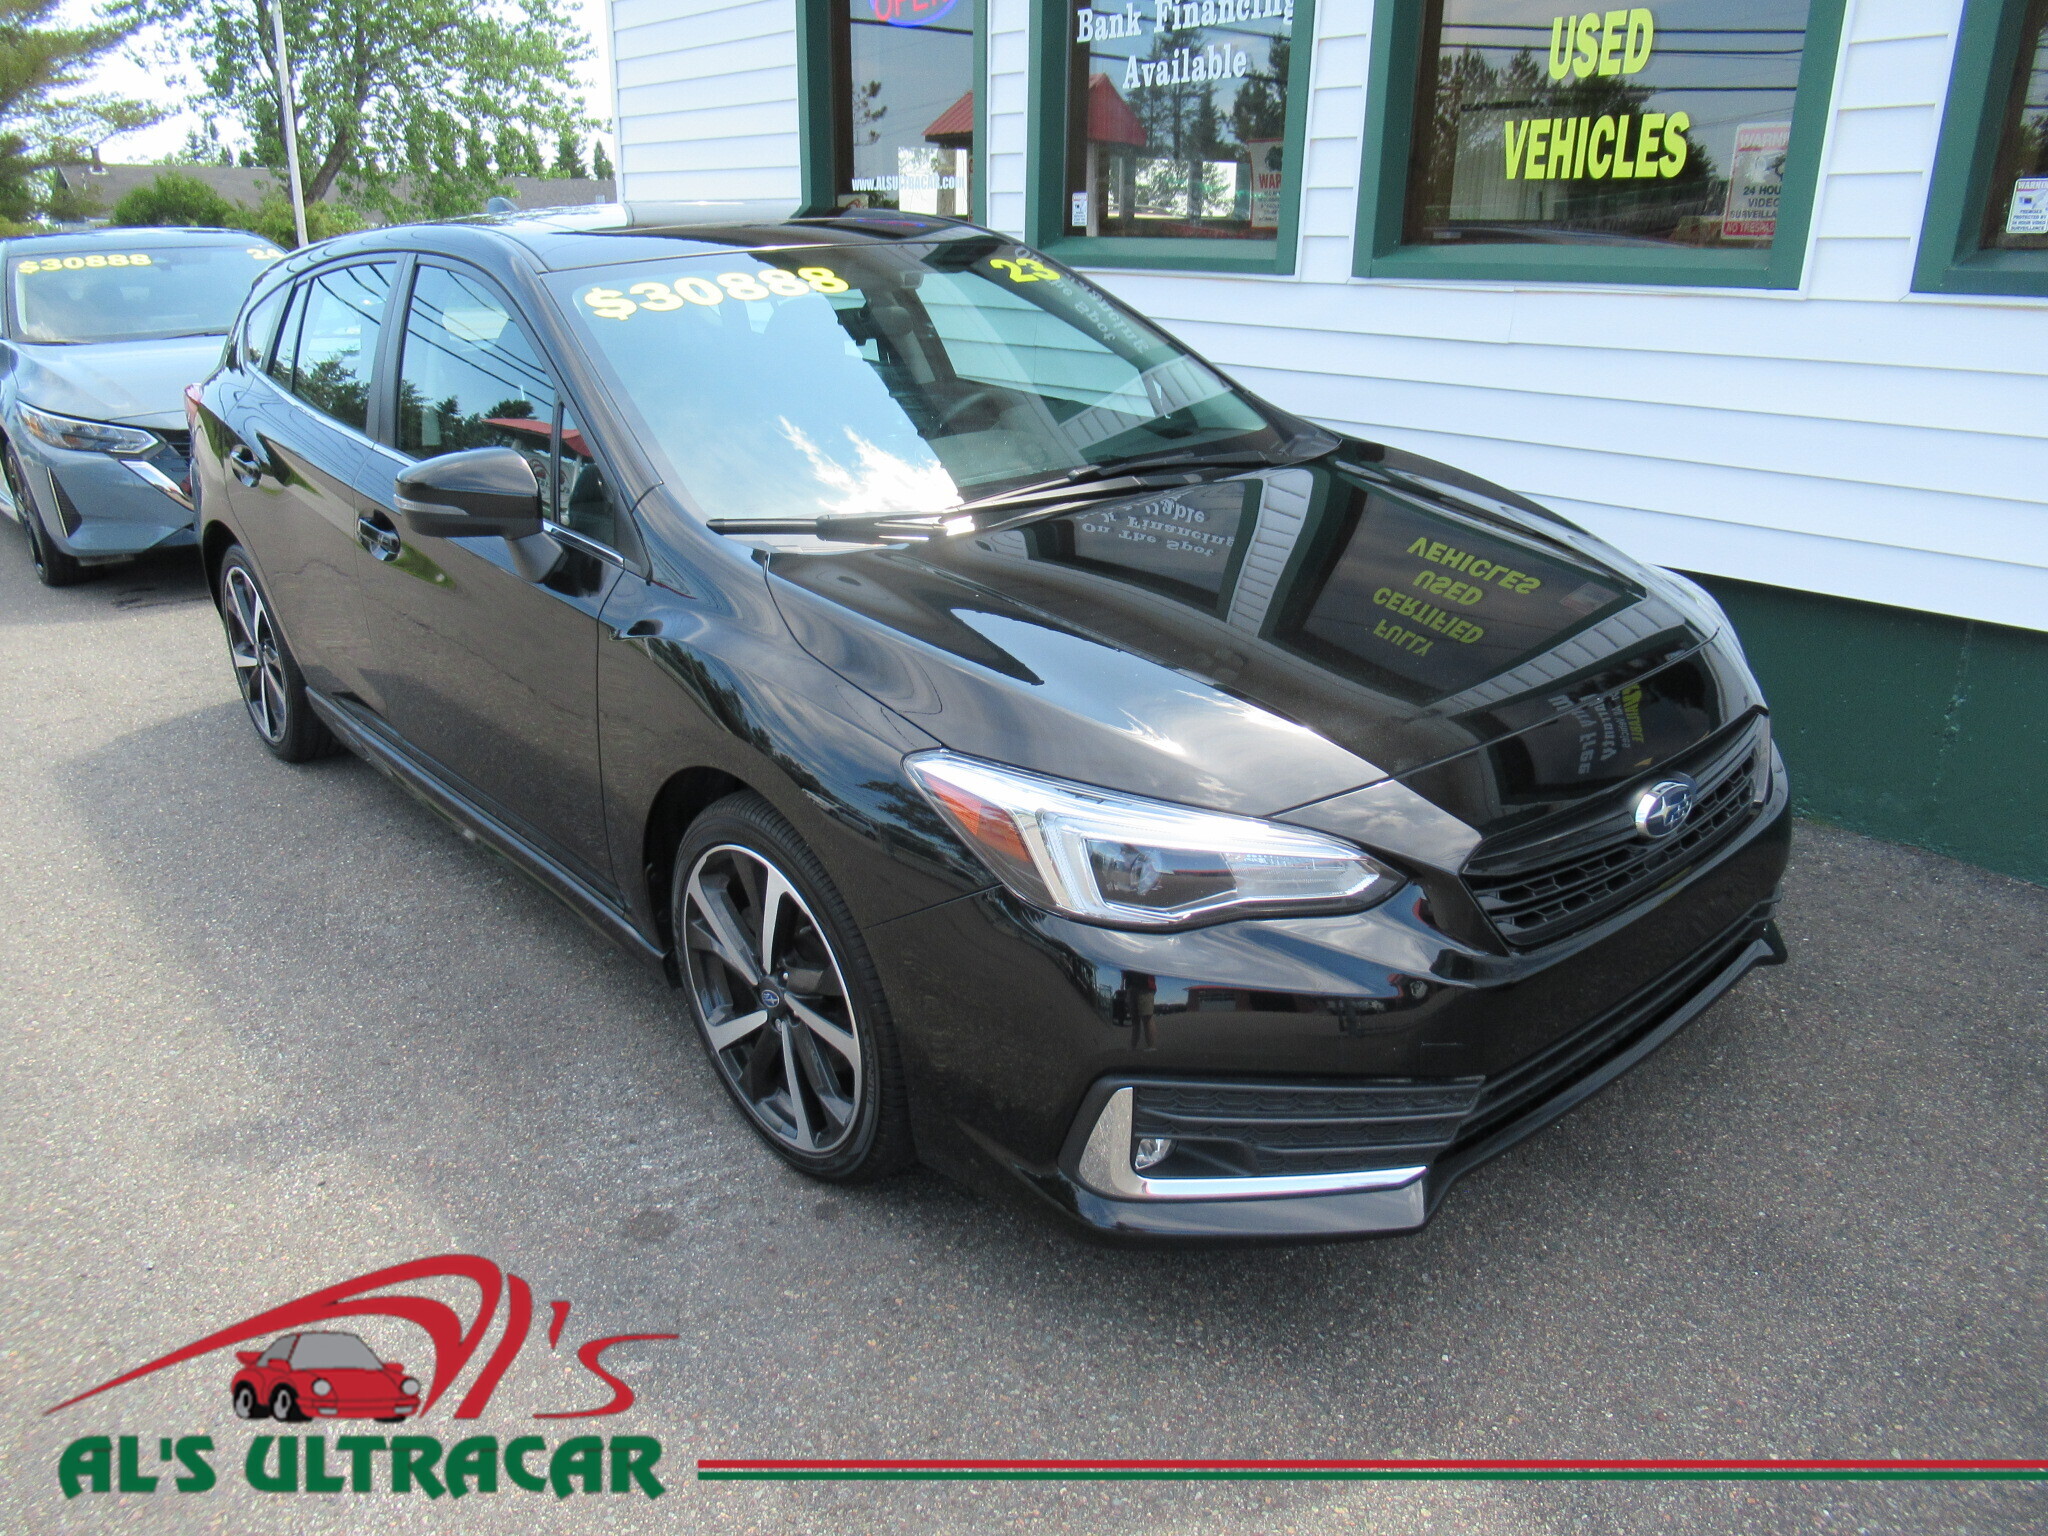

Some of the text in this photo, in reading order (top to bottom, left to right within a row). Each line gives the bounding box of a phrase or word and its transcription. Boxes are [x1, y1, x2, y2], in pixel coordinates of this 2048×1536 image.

[1077, 0, 1293, 42] Bank Financing
[1549, 8, 1654, 79] USED
[1123, 43, 1247, 89] Available
[1505, 111, 1690, 179] VEHICLES
[1743, 185, 1780, 196] 24 HOU
[1730, 210, 1776, 219] SURVEILLA
[18, 254, 152, 274] $30888
[989, 258, 1061, 283] 23
[584, 267, 850, 321] $30888
